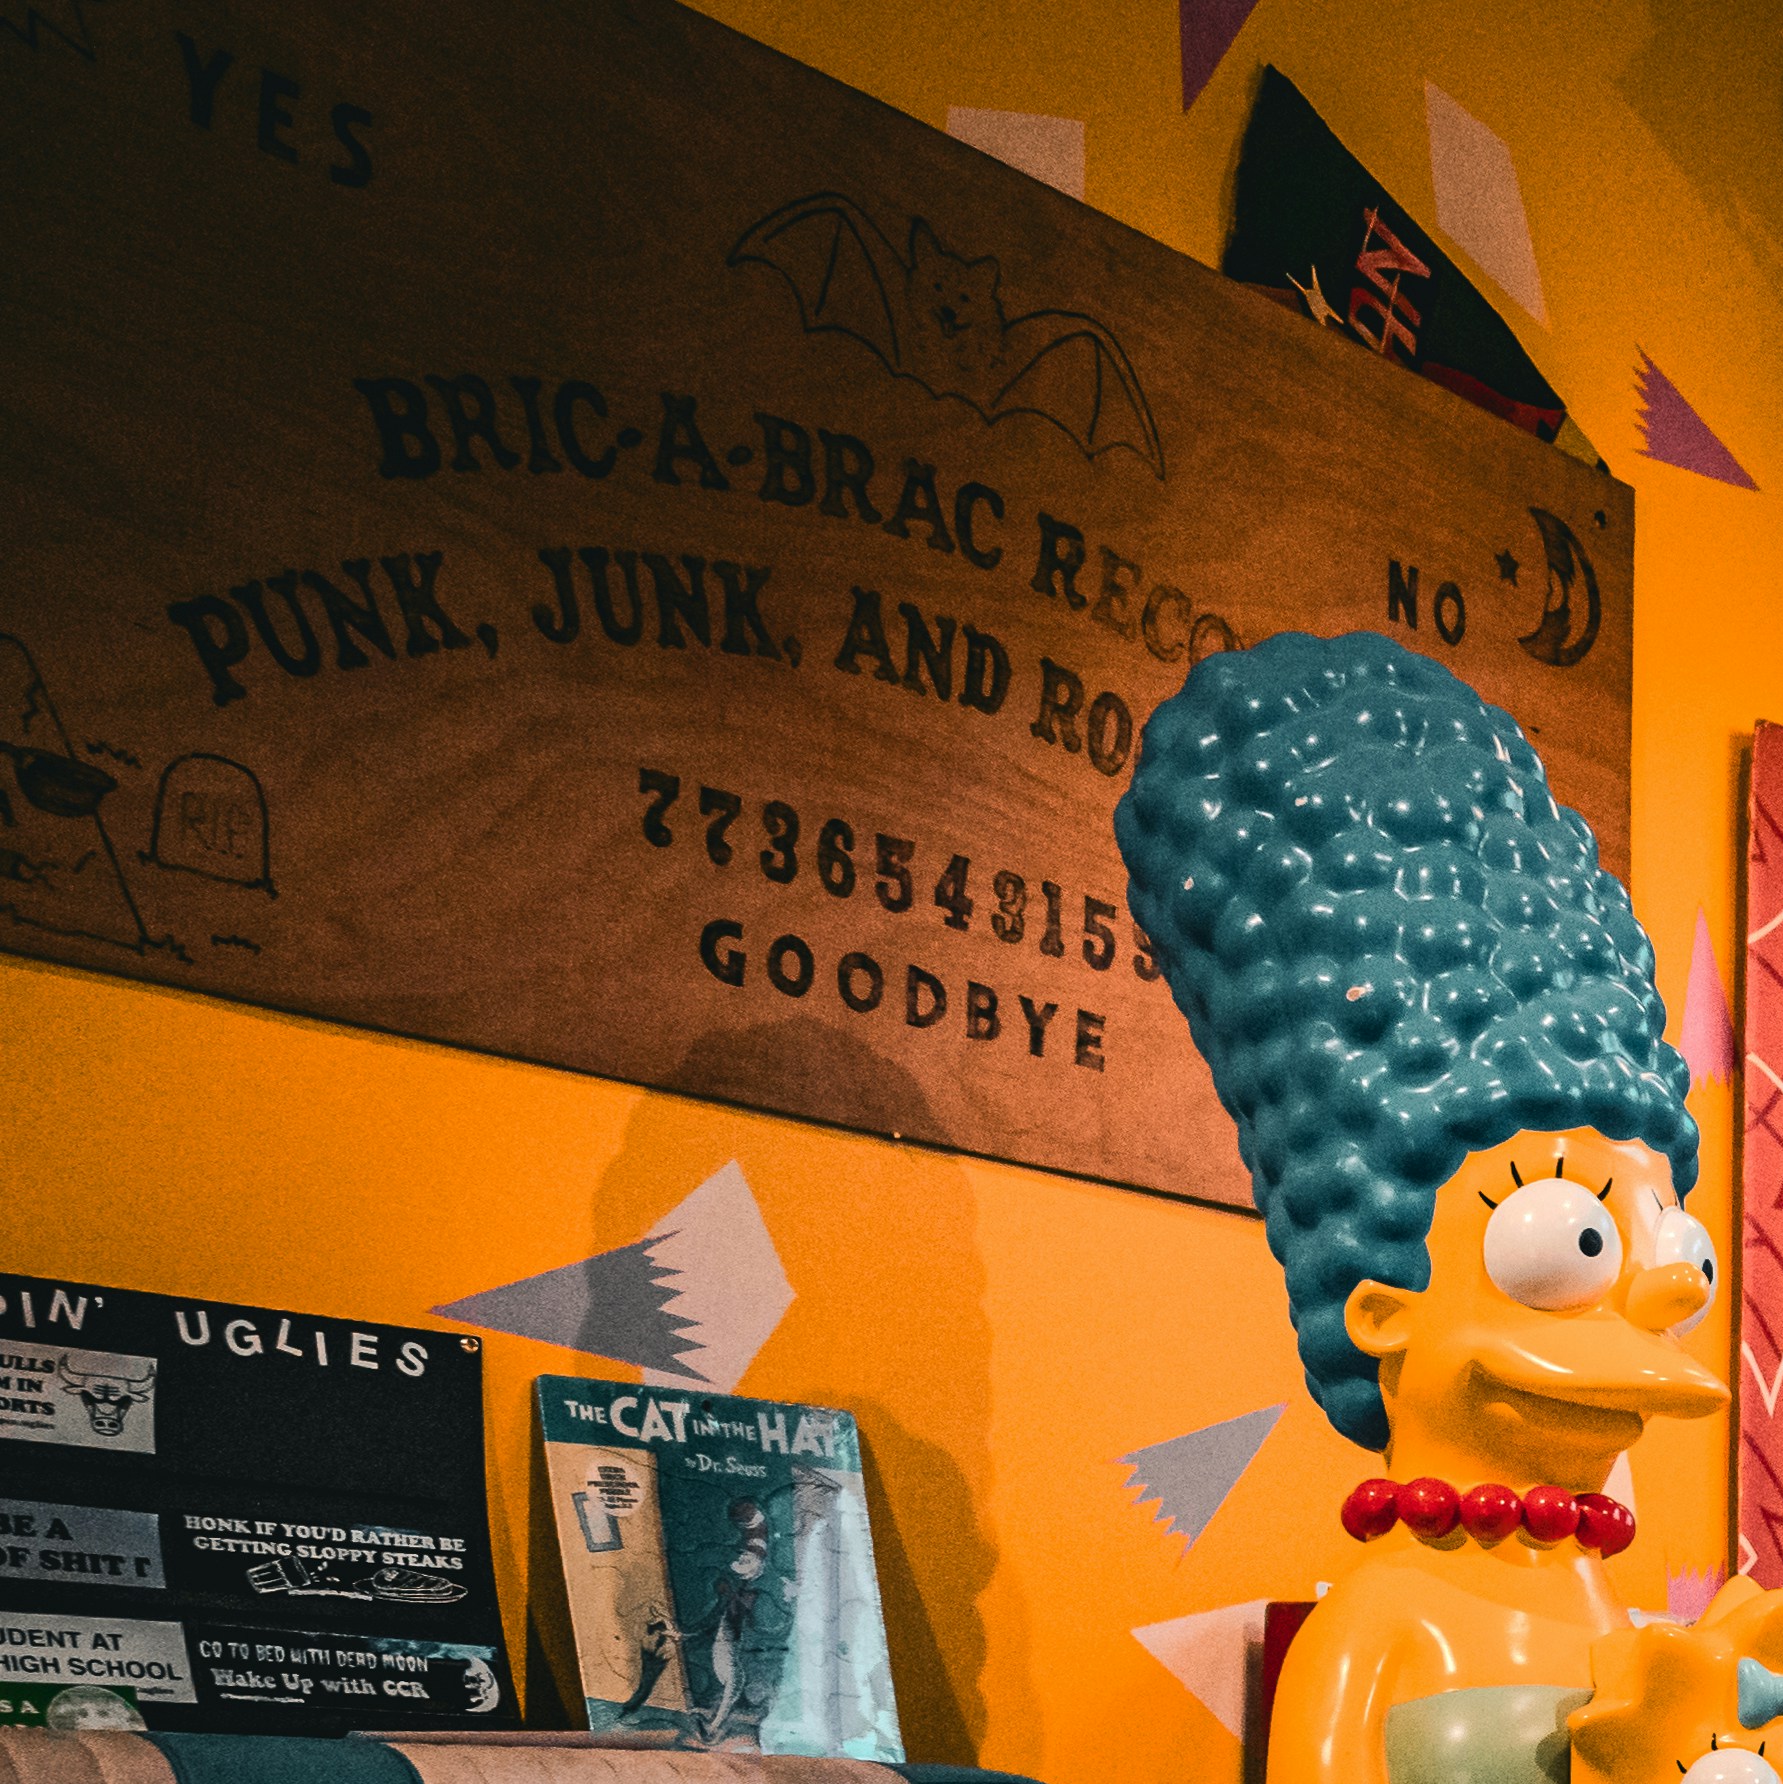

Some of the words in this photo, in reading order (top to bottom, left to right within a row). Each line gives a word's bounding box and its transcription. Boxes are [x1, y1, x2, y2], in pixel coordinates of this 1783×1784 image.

[176, 31, 374, 190] YES
[1387, 557, 1466, 646] NO
[167, 550, 500, 702] PUNK,
[532, 546, 803, 668] JUNK,
[833, 584, 1012, 718] AND
[699, 919, 1107, 1073] GOODBYE
[175, 1309, 430, 1379] UGLIES
[565, 1401, 606, 1424] THE
[609, 1397, 692, 1442] CAT
[757, 1412, 838, 1457] HAT
[695, 1454, 722, 1474] Dr.
[45, 1518, 74, 1541] A
[183, 1515, 252, 1534] HONK
[254, 1521, 277, 1537] IF
[283, 1523, 347, 1541] YOU'D
[351, 1529, 433, 1549] RATHER
[438, 1537, 466, 1552] BE
[39, 1550, 126, 1576] SHIT
[193, 1536, 292, 1557] GETTING
[295, 1545, 378, 1565] SLOPPY
[381, 1552, 465, 1570] STEAKS
[92, 1634, 123, 1651] AT
[255, 1644, 285, 1663] BED
[289, 1648, 331, 1665] WITH
[382, 1655, 429, 1672] MOON
[68, 1658, 184, 1681] SCHOOL
[280, 1673, 314, 1695] Up
[320, 1677, 376, 1696] with
